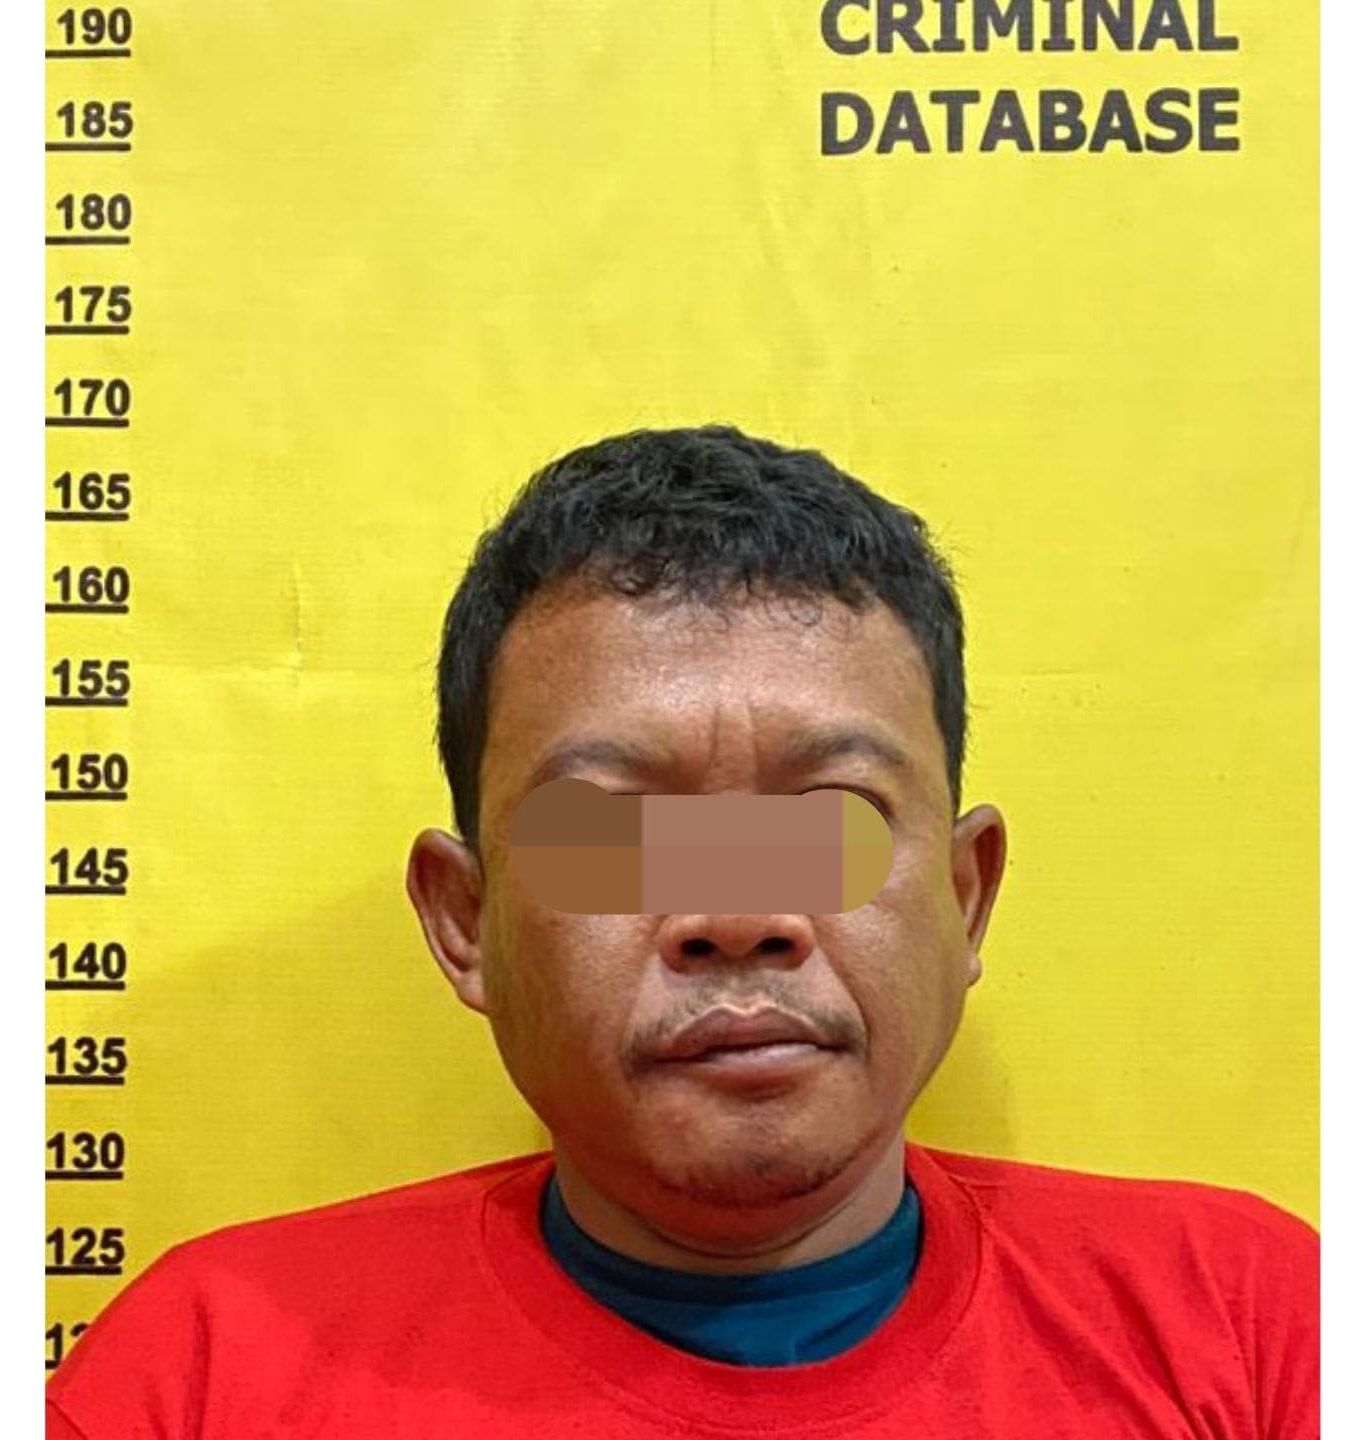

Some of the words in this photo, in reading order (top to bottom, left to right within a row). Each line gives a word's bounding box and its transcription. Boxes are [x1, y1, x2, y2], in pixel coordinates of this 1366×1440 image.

[59, 9, 131, 44] 190
[820, 0, 1239, 54] CRIMINAL
[59, 102, 132, 137] 185
[820, 88, 1240, 155] DATABASE
[57, 194, 130, 229] 180
[56, 287, 131, 321] 175
[55, 380, 129, 415] 170
[54, 473, 130, 510] 165
[54, 567, 129, 603] 160
[53, 660, 129, 699] 155
[52, 754, 127, 791] 150
[50, 849, 128, 887] 145
[50, 943, 126, 980] 140
[48, 1037, 126, 1077] 135
[47, 1133, 124, 1172] 130
[46, 1228, 124, 1266] 125
